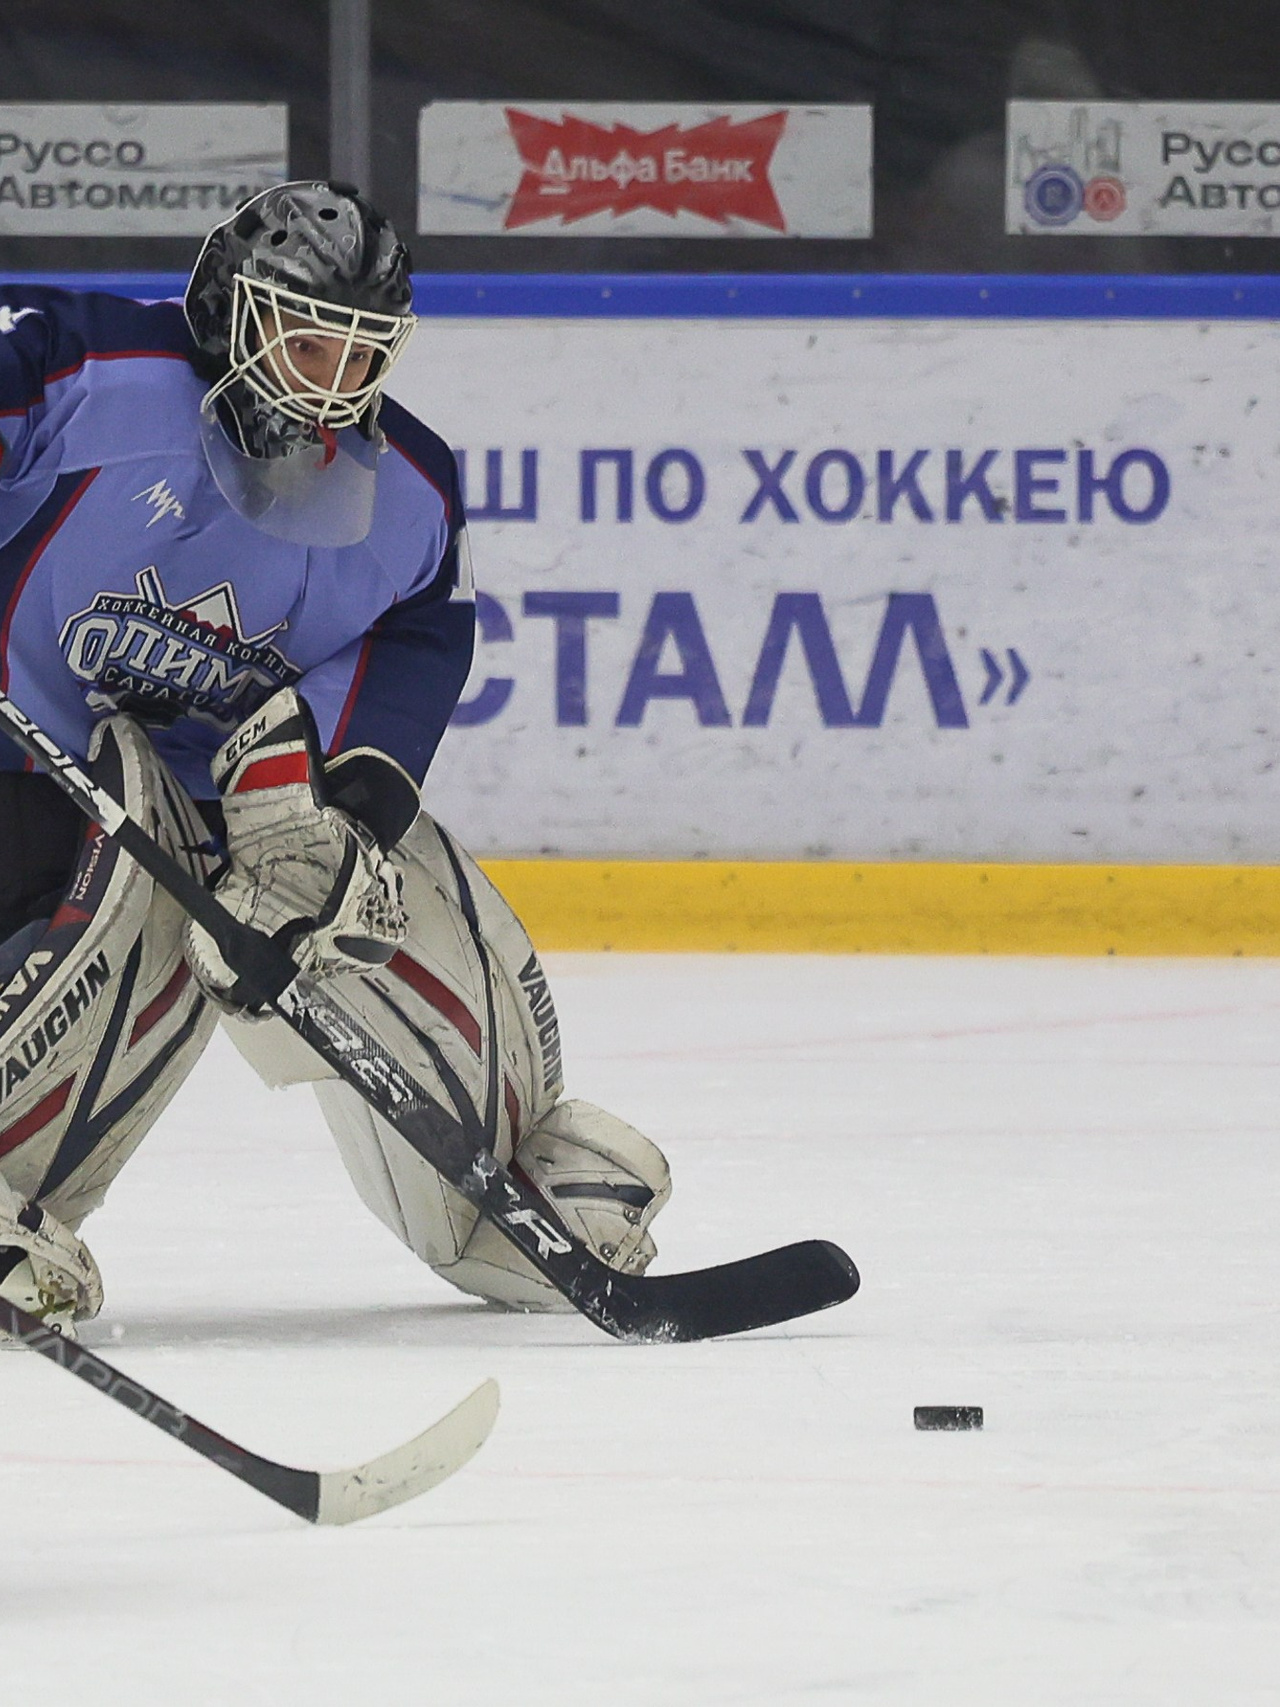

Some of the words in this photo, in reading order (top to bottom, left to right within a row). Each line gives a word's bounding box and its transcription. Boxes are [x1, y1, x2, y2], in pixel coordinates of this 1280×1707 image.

[540, 148, 657, 190] Альфа
[664, 148, 755, 184] Банк
[578, 448, 706, 523] ПО
[740, 448, 1170, 524] ХОККЕЮ
[97, 598, 218, 648] ХОККЕЙНАЯ
[225, 715, 268, 763] CCM
[75, 833, 106, 901] VISION
